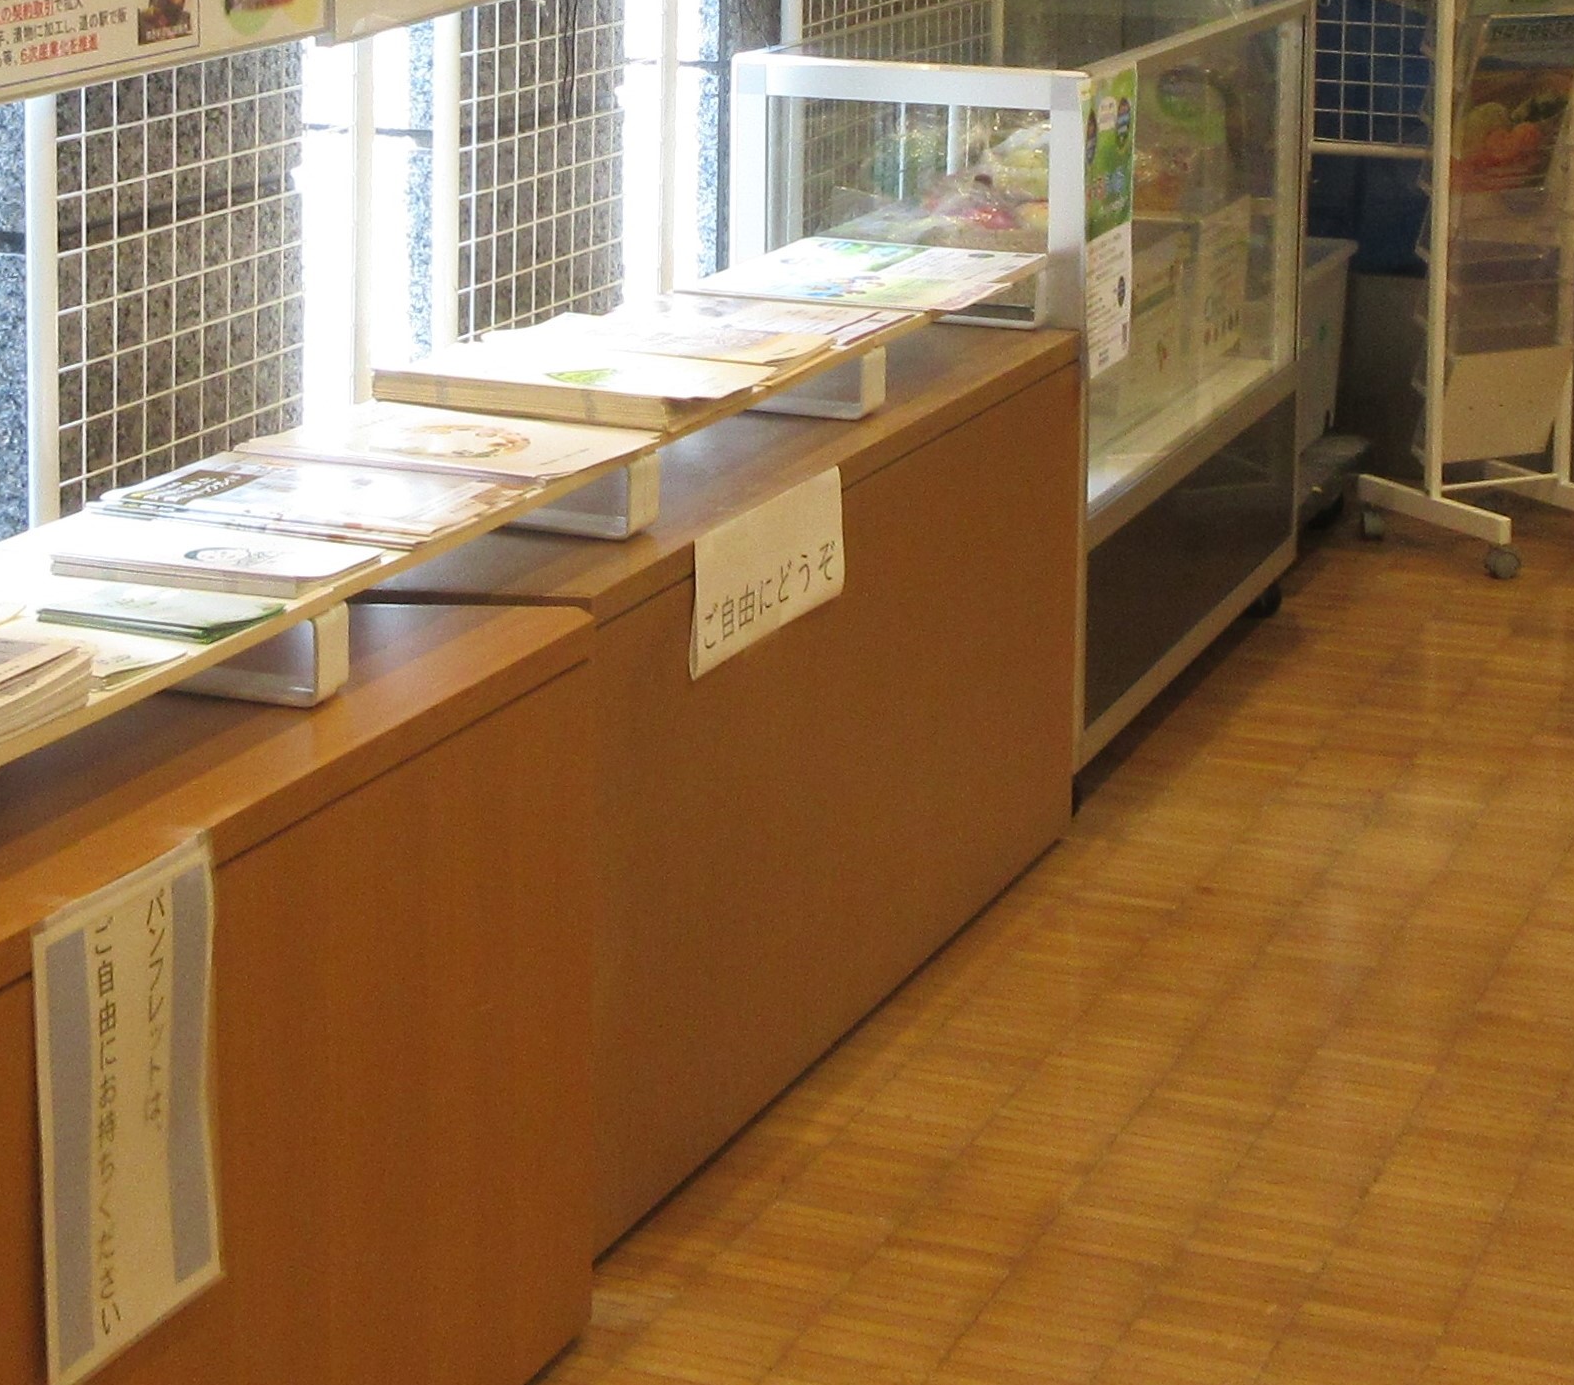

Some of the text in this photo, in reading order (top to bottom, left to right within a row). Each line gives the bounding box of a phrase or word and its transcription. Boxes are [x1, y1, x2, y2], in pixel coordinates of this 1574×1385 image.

[704, 540, 837, 650] ご自由にどうぞ
[94, 915, 124, 1336] ご自由にお持ちください
